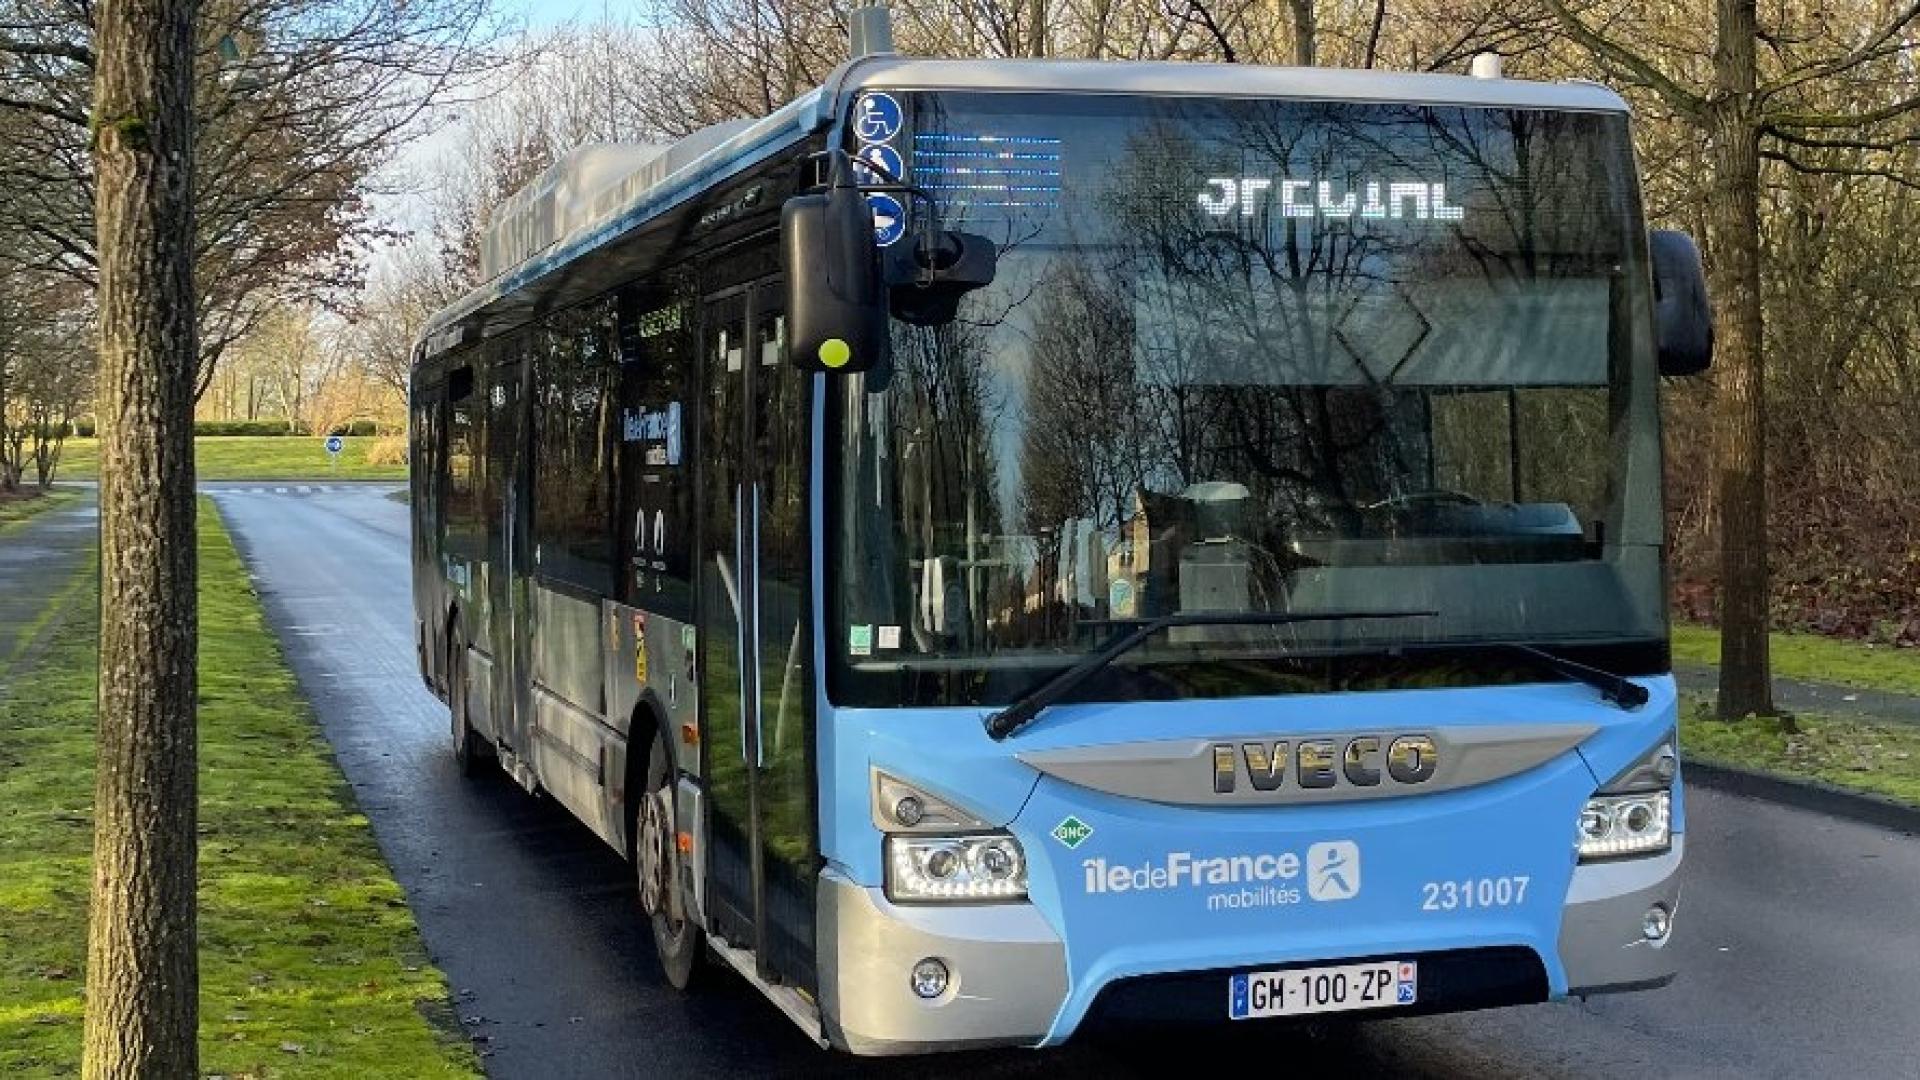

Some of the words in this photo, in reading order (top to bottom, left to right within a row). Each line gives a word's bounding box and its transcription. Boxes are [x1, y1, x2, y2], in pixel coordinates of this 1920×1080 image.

[1213, 734, 1438, 793] IVECO
[1207, 882, 1300, 911] mobilités
[1422, 876, 1530, 910] 231007
